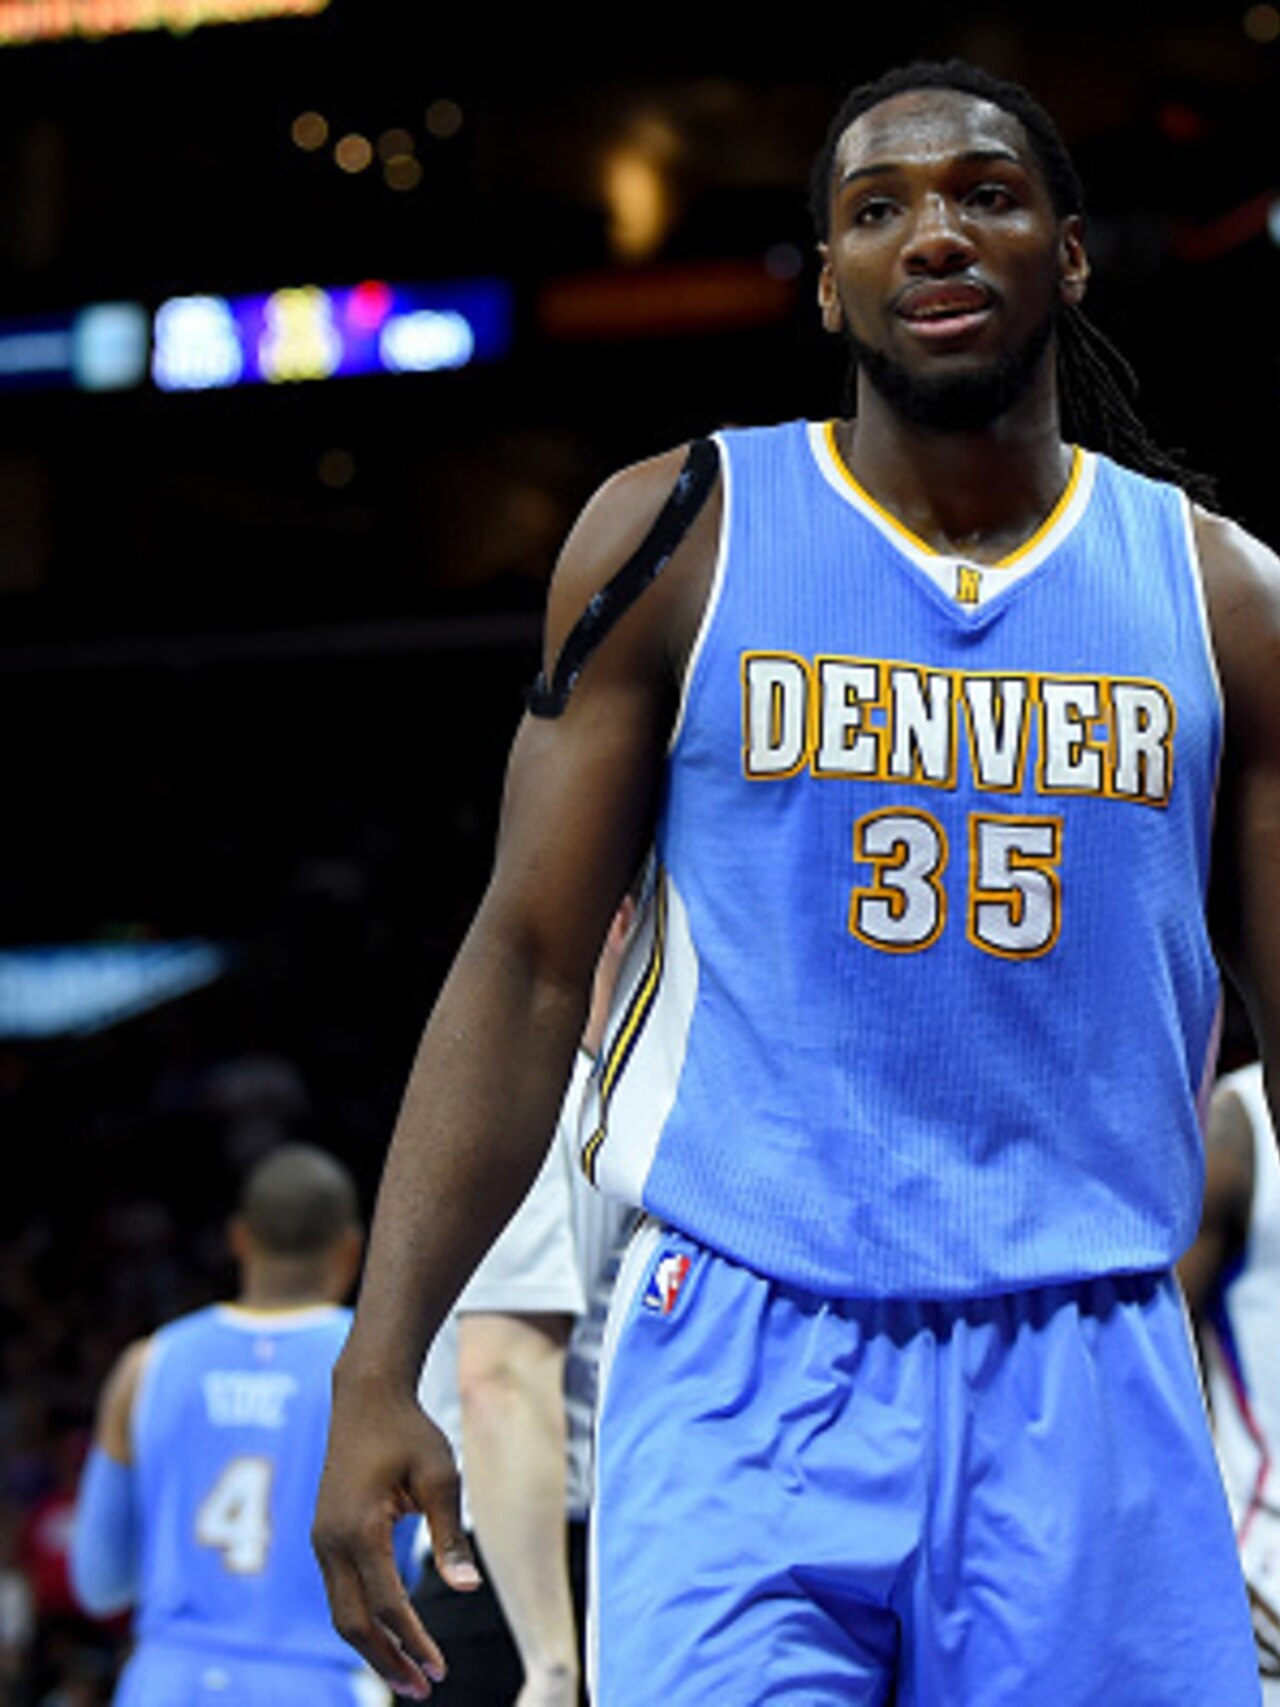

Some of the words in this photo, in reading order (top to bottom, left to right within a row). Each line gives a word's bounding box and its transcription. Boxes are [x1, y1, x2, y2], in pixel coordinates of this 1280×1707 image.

[741, 651, 1176, 808] DENVER
[849, 806, 1063, 960] 35
[195, 1454, 274, 1577] 4
